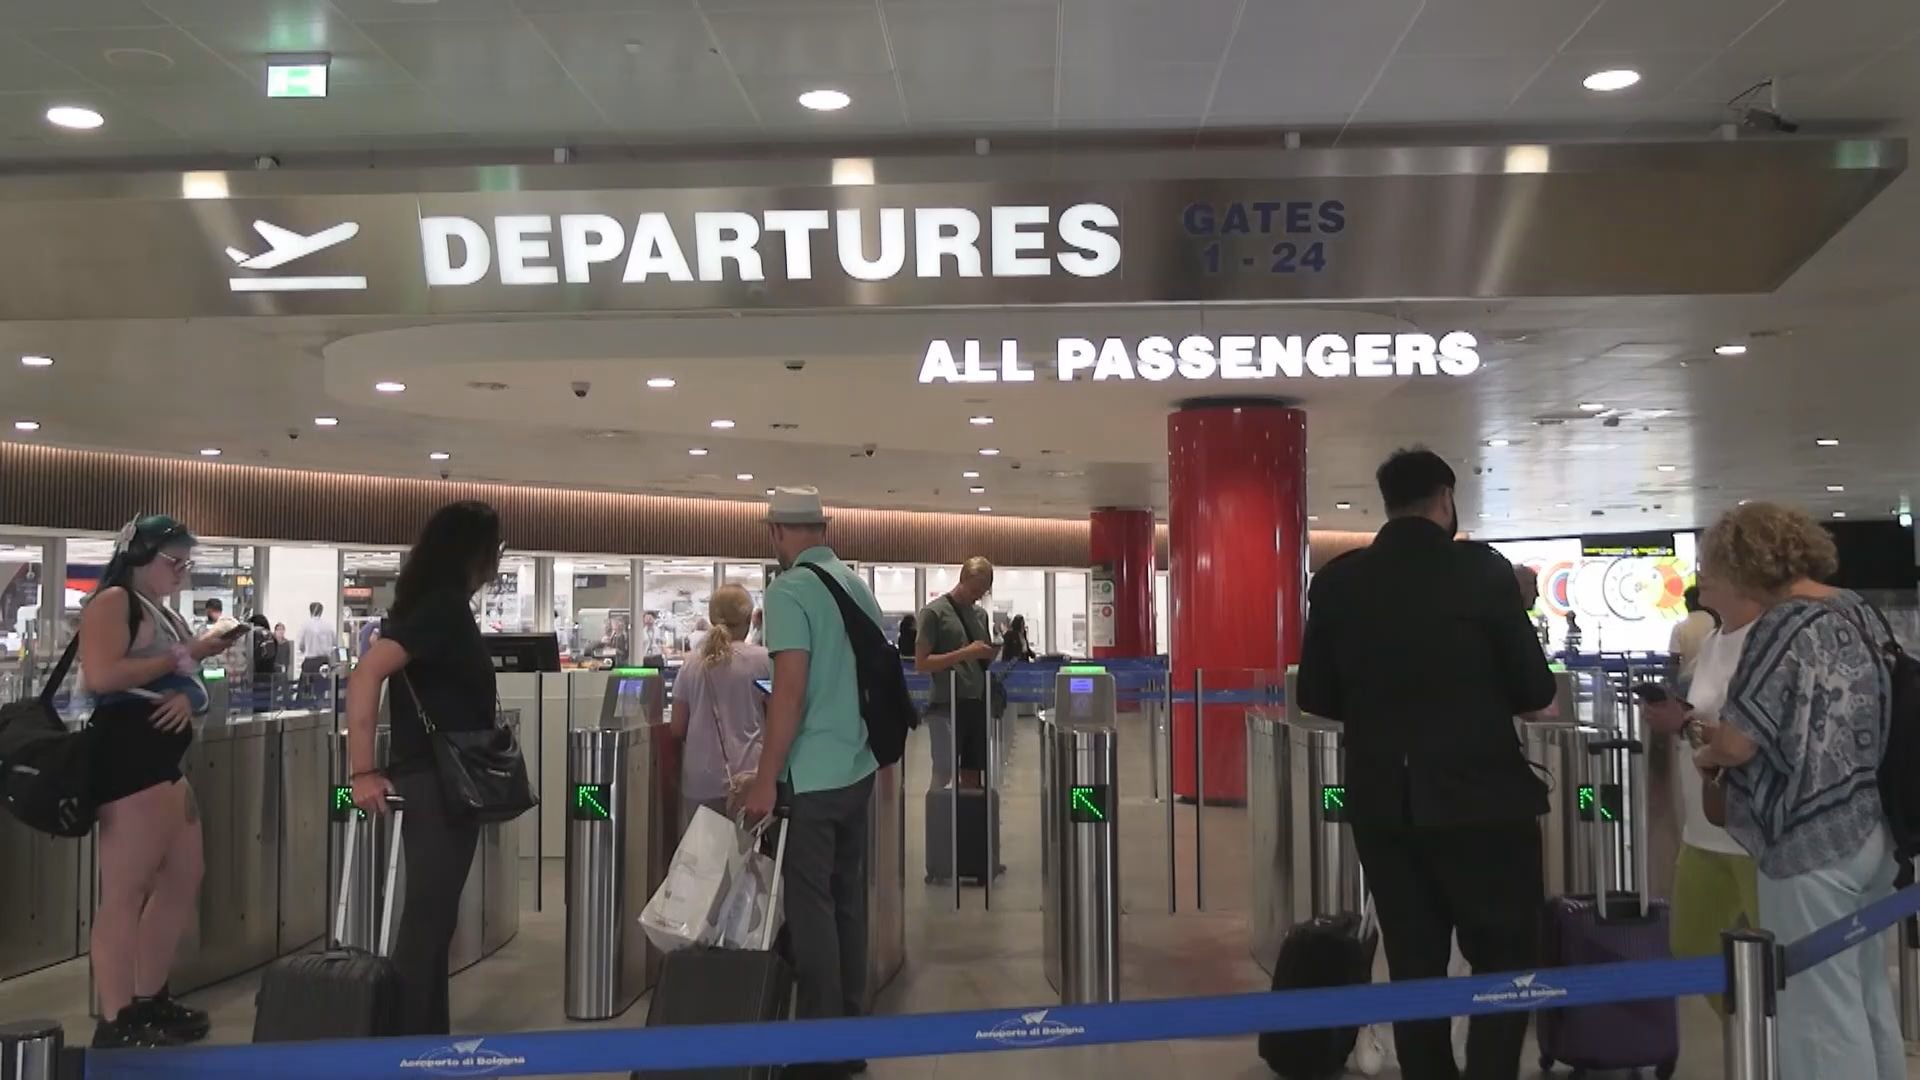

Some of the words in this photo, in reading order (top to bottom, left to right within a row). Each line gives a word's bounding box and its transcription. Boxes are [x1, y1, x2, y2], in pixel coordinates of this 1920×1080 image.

[1183, 200, 1345, 234] GATES
[420, 203, 1121, 285] DEPARTURES
[1203, 243, 1220, 272] 1
[1271, 242, 1326, 273] 24
[918, 339, 1034, 383] ALL
[1057, 331, 1480, 381] PASSENGERS
[976, 1028, 1027, 1039] Aeroporto
[1029, 1027, 1040, 1036] di
[1042, 1026, 1084, 1035] Bologna
[400, 1057, 459, 1067] Aeroporto
[462, 1057, 474, 1066] di
[476, 1056, 525, 1065] Bologna
